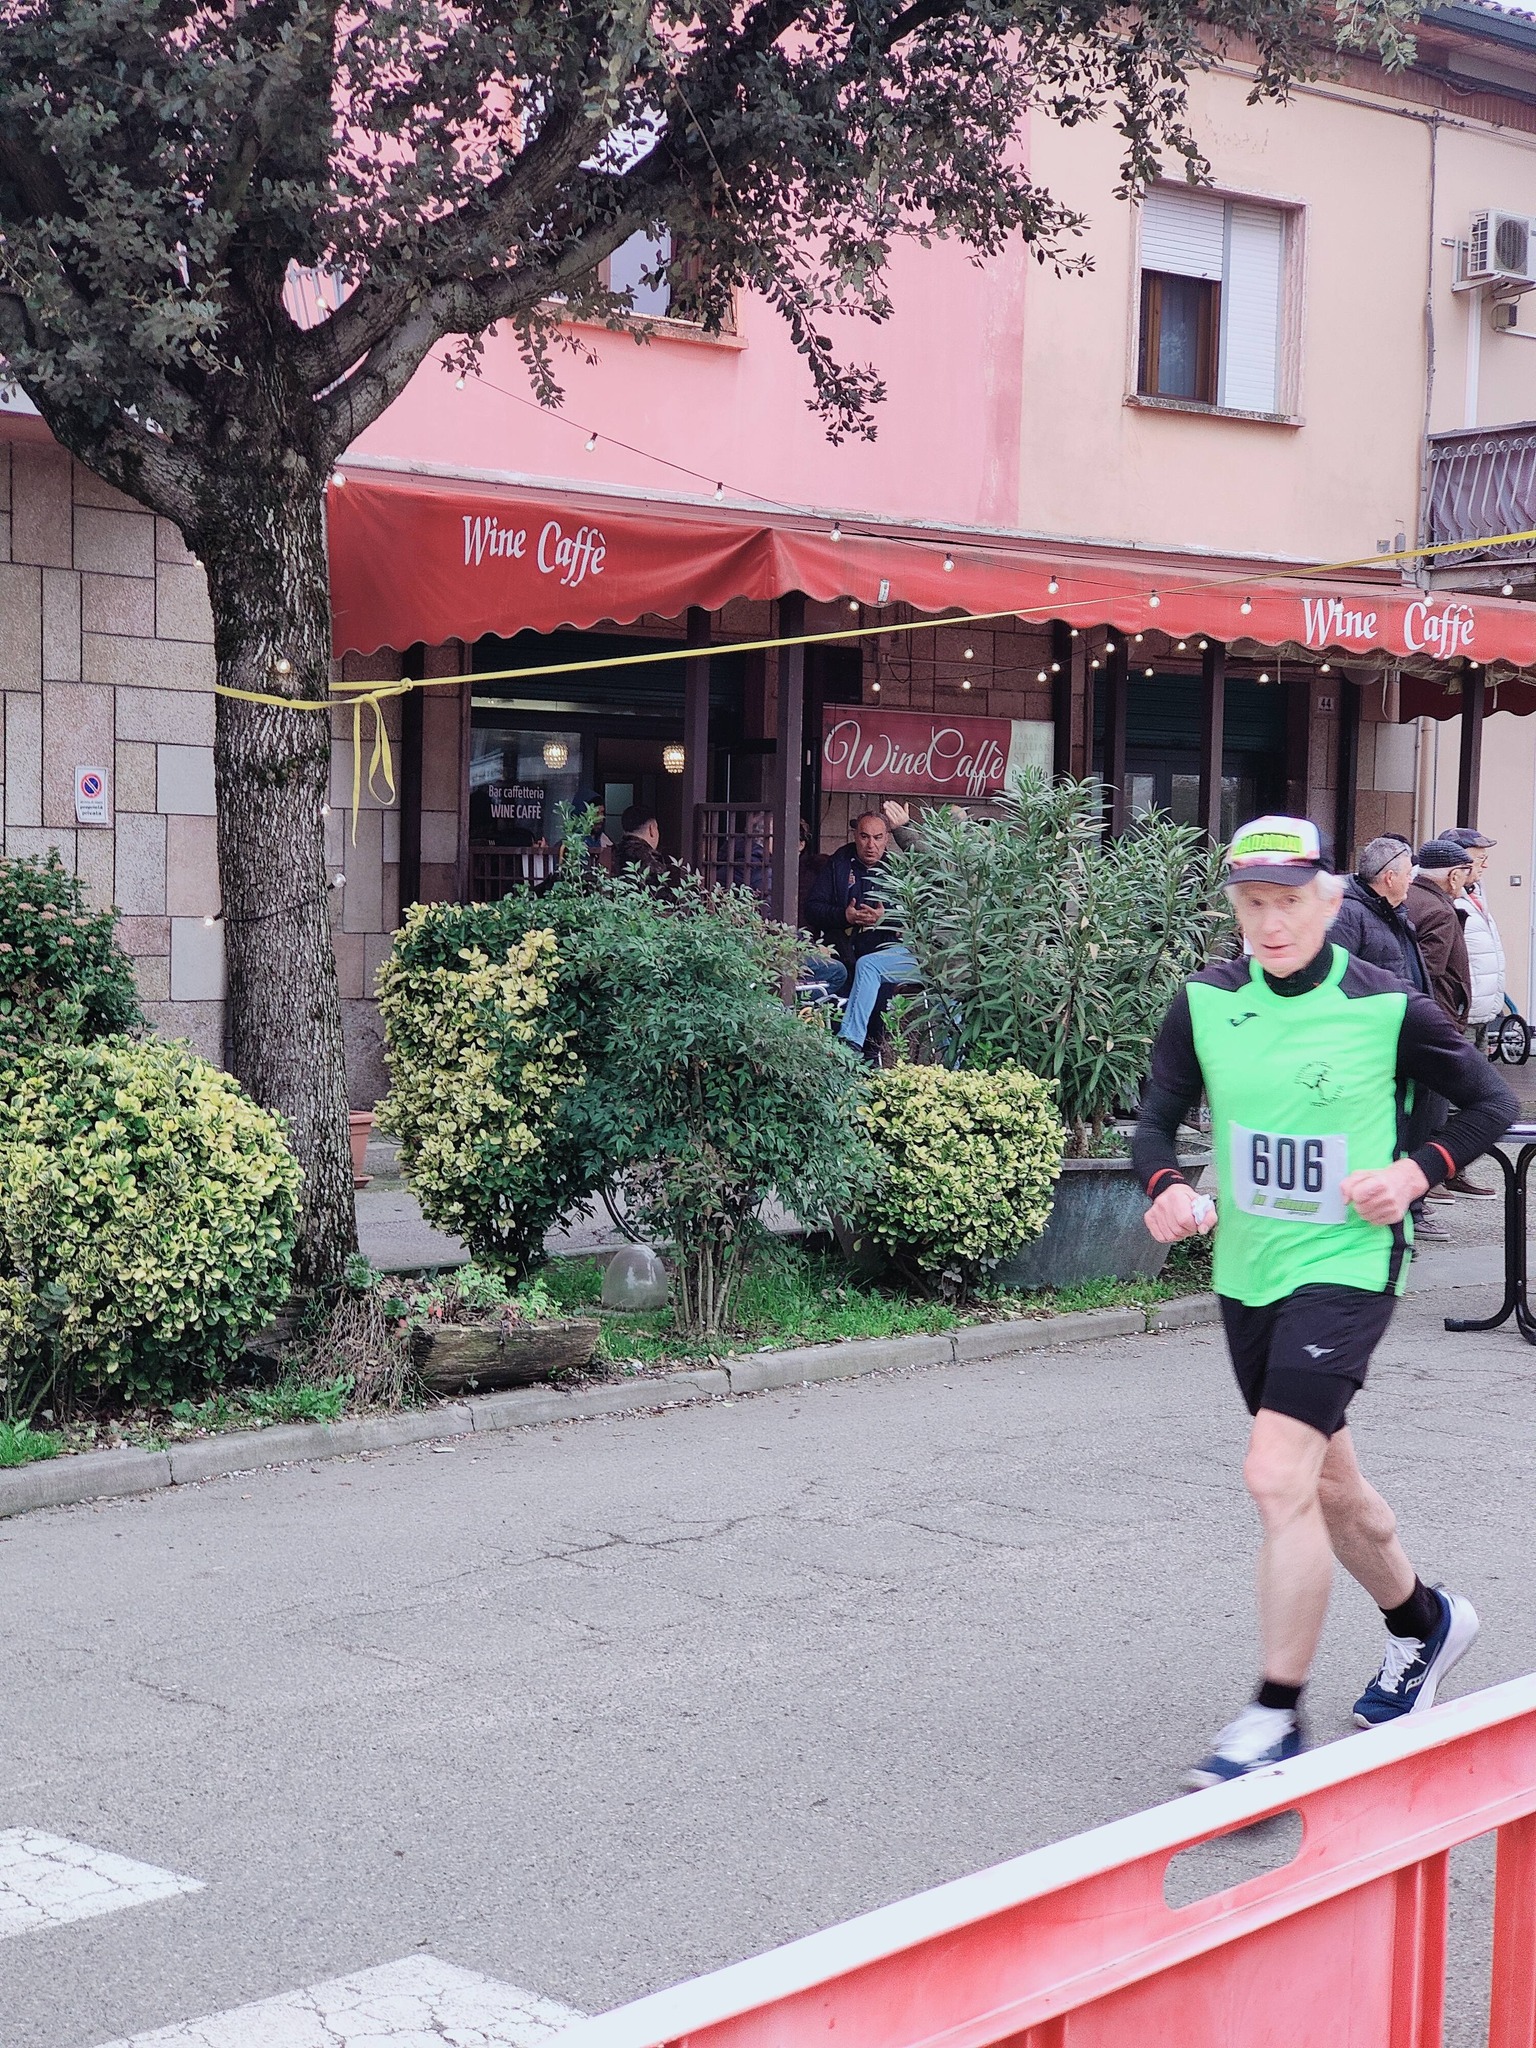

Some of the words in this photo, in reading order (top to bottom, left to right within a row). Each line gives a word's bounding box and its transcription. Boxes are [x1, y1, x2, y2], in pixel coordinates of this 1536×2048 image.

[462, 515, 527, 567] Wine
[537, 520, 607, 588] Caffè
[1301, 597, 1379, 647] Wine
[1403, 600, 1476, 660] Caffè
[1321, 698, 1331, 708] 44
[1014, 741, 1052, 752] ITALIAN
[1013, 752, 1051, 765] STYLE
[488, 784, 502, 798] Bar
[503, 785, 544, 799] caffetteria
[490, 803, 515, 818] WINE
[516, 801, 541, 819] CAFFÈ
[1251, 1133, 1324, 1193] 606
